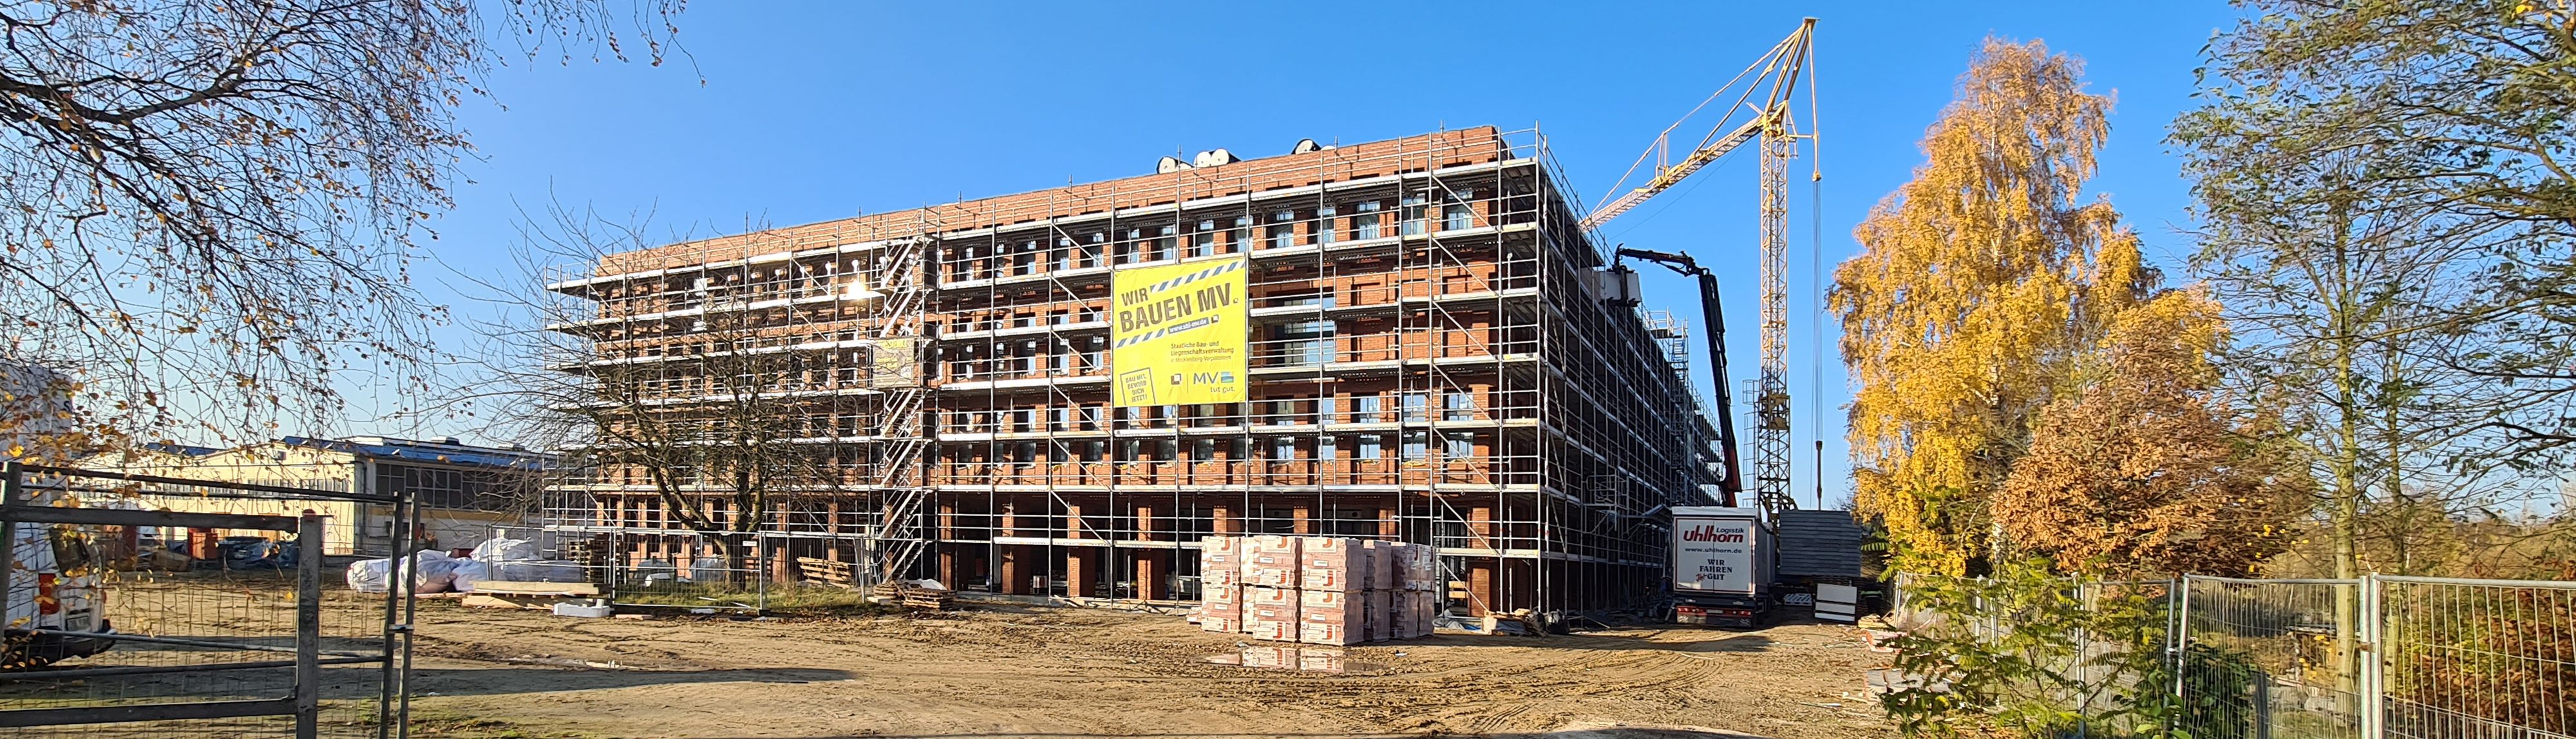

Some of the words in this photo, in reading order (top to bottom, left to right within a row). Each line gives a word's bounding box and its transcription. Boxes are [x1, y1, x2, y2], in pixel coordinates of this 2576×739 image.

[1121, 288, 1148, 306] WIR
[1119, 294, 1192, 332] BAUEN
[1193, 372, 1218, 384] MV
[1683, 525, 1743, 543] uhlhorn
